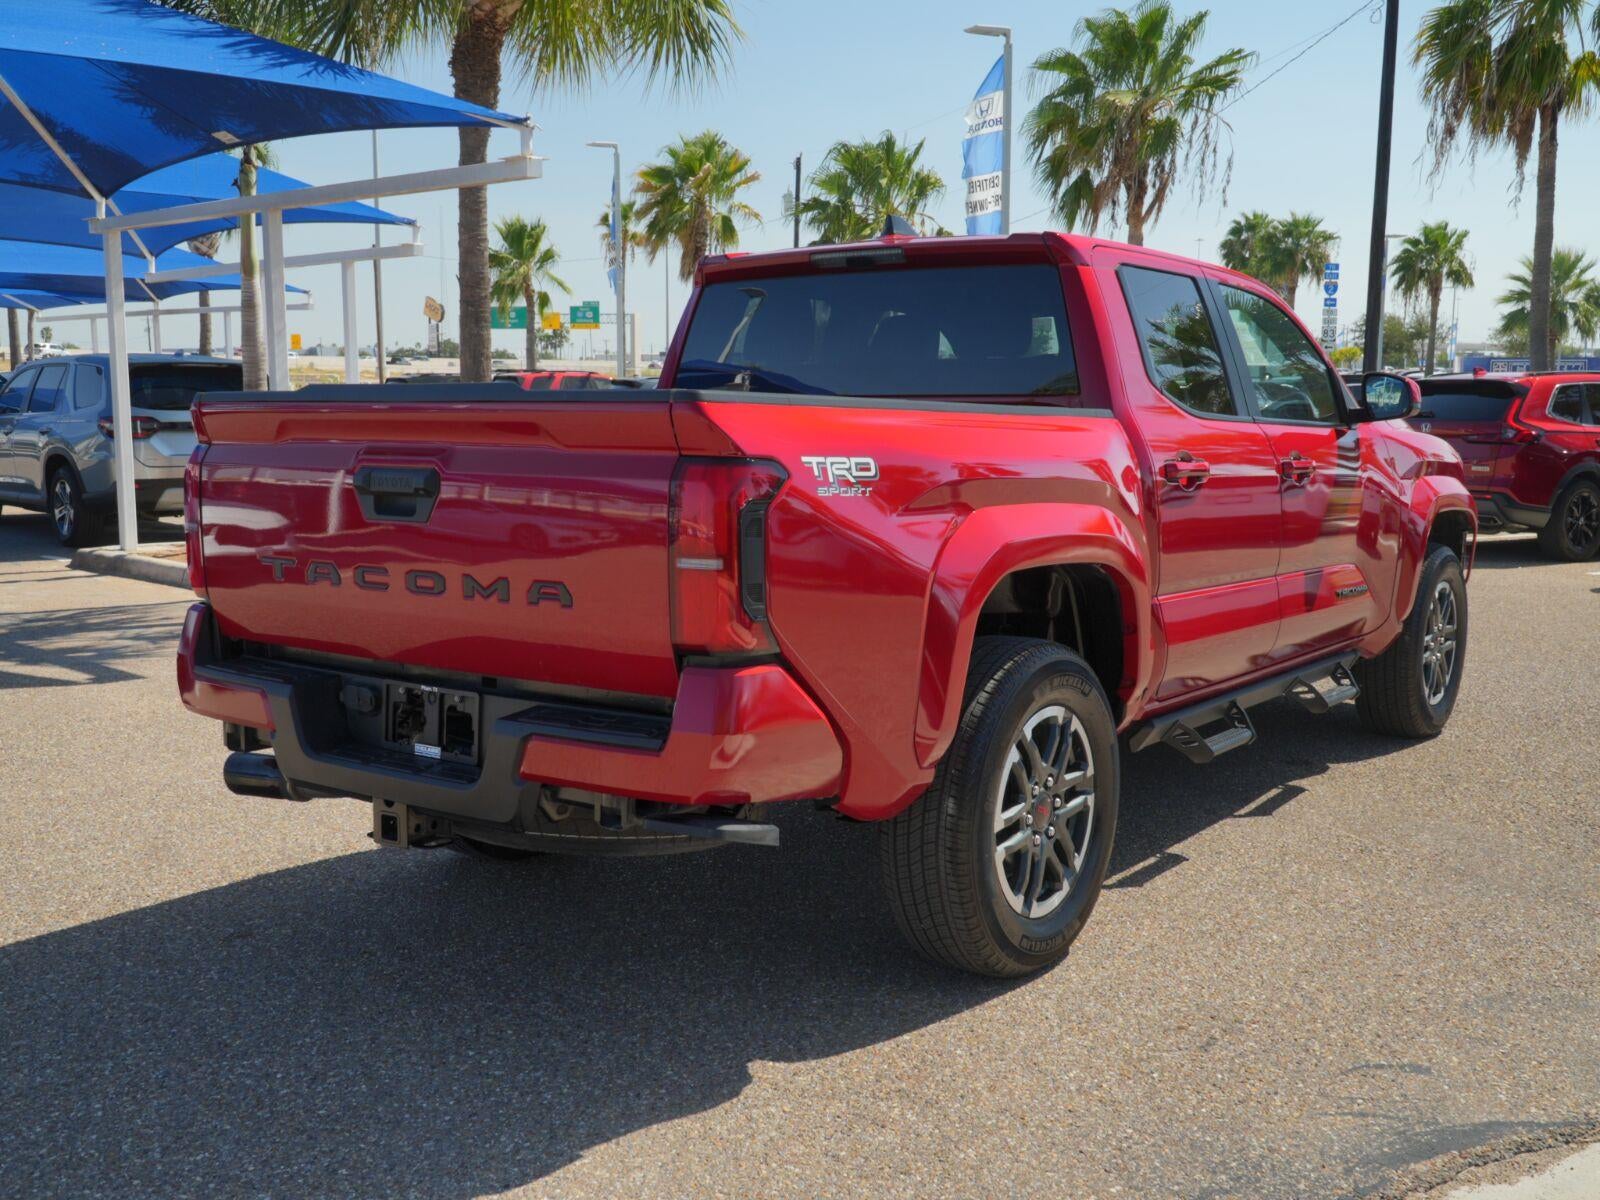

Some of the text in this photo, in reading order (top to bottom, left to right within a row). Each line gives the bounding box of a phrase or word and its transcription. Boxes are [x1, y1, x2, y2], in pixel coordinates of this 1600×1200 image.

[1322, 329, 1335, 338] 83
[801, 455, 877, 484] TRD
[817, 487, 873, 497] SPORT
[258, 555, 574, 609] TACOMA
